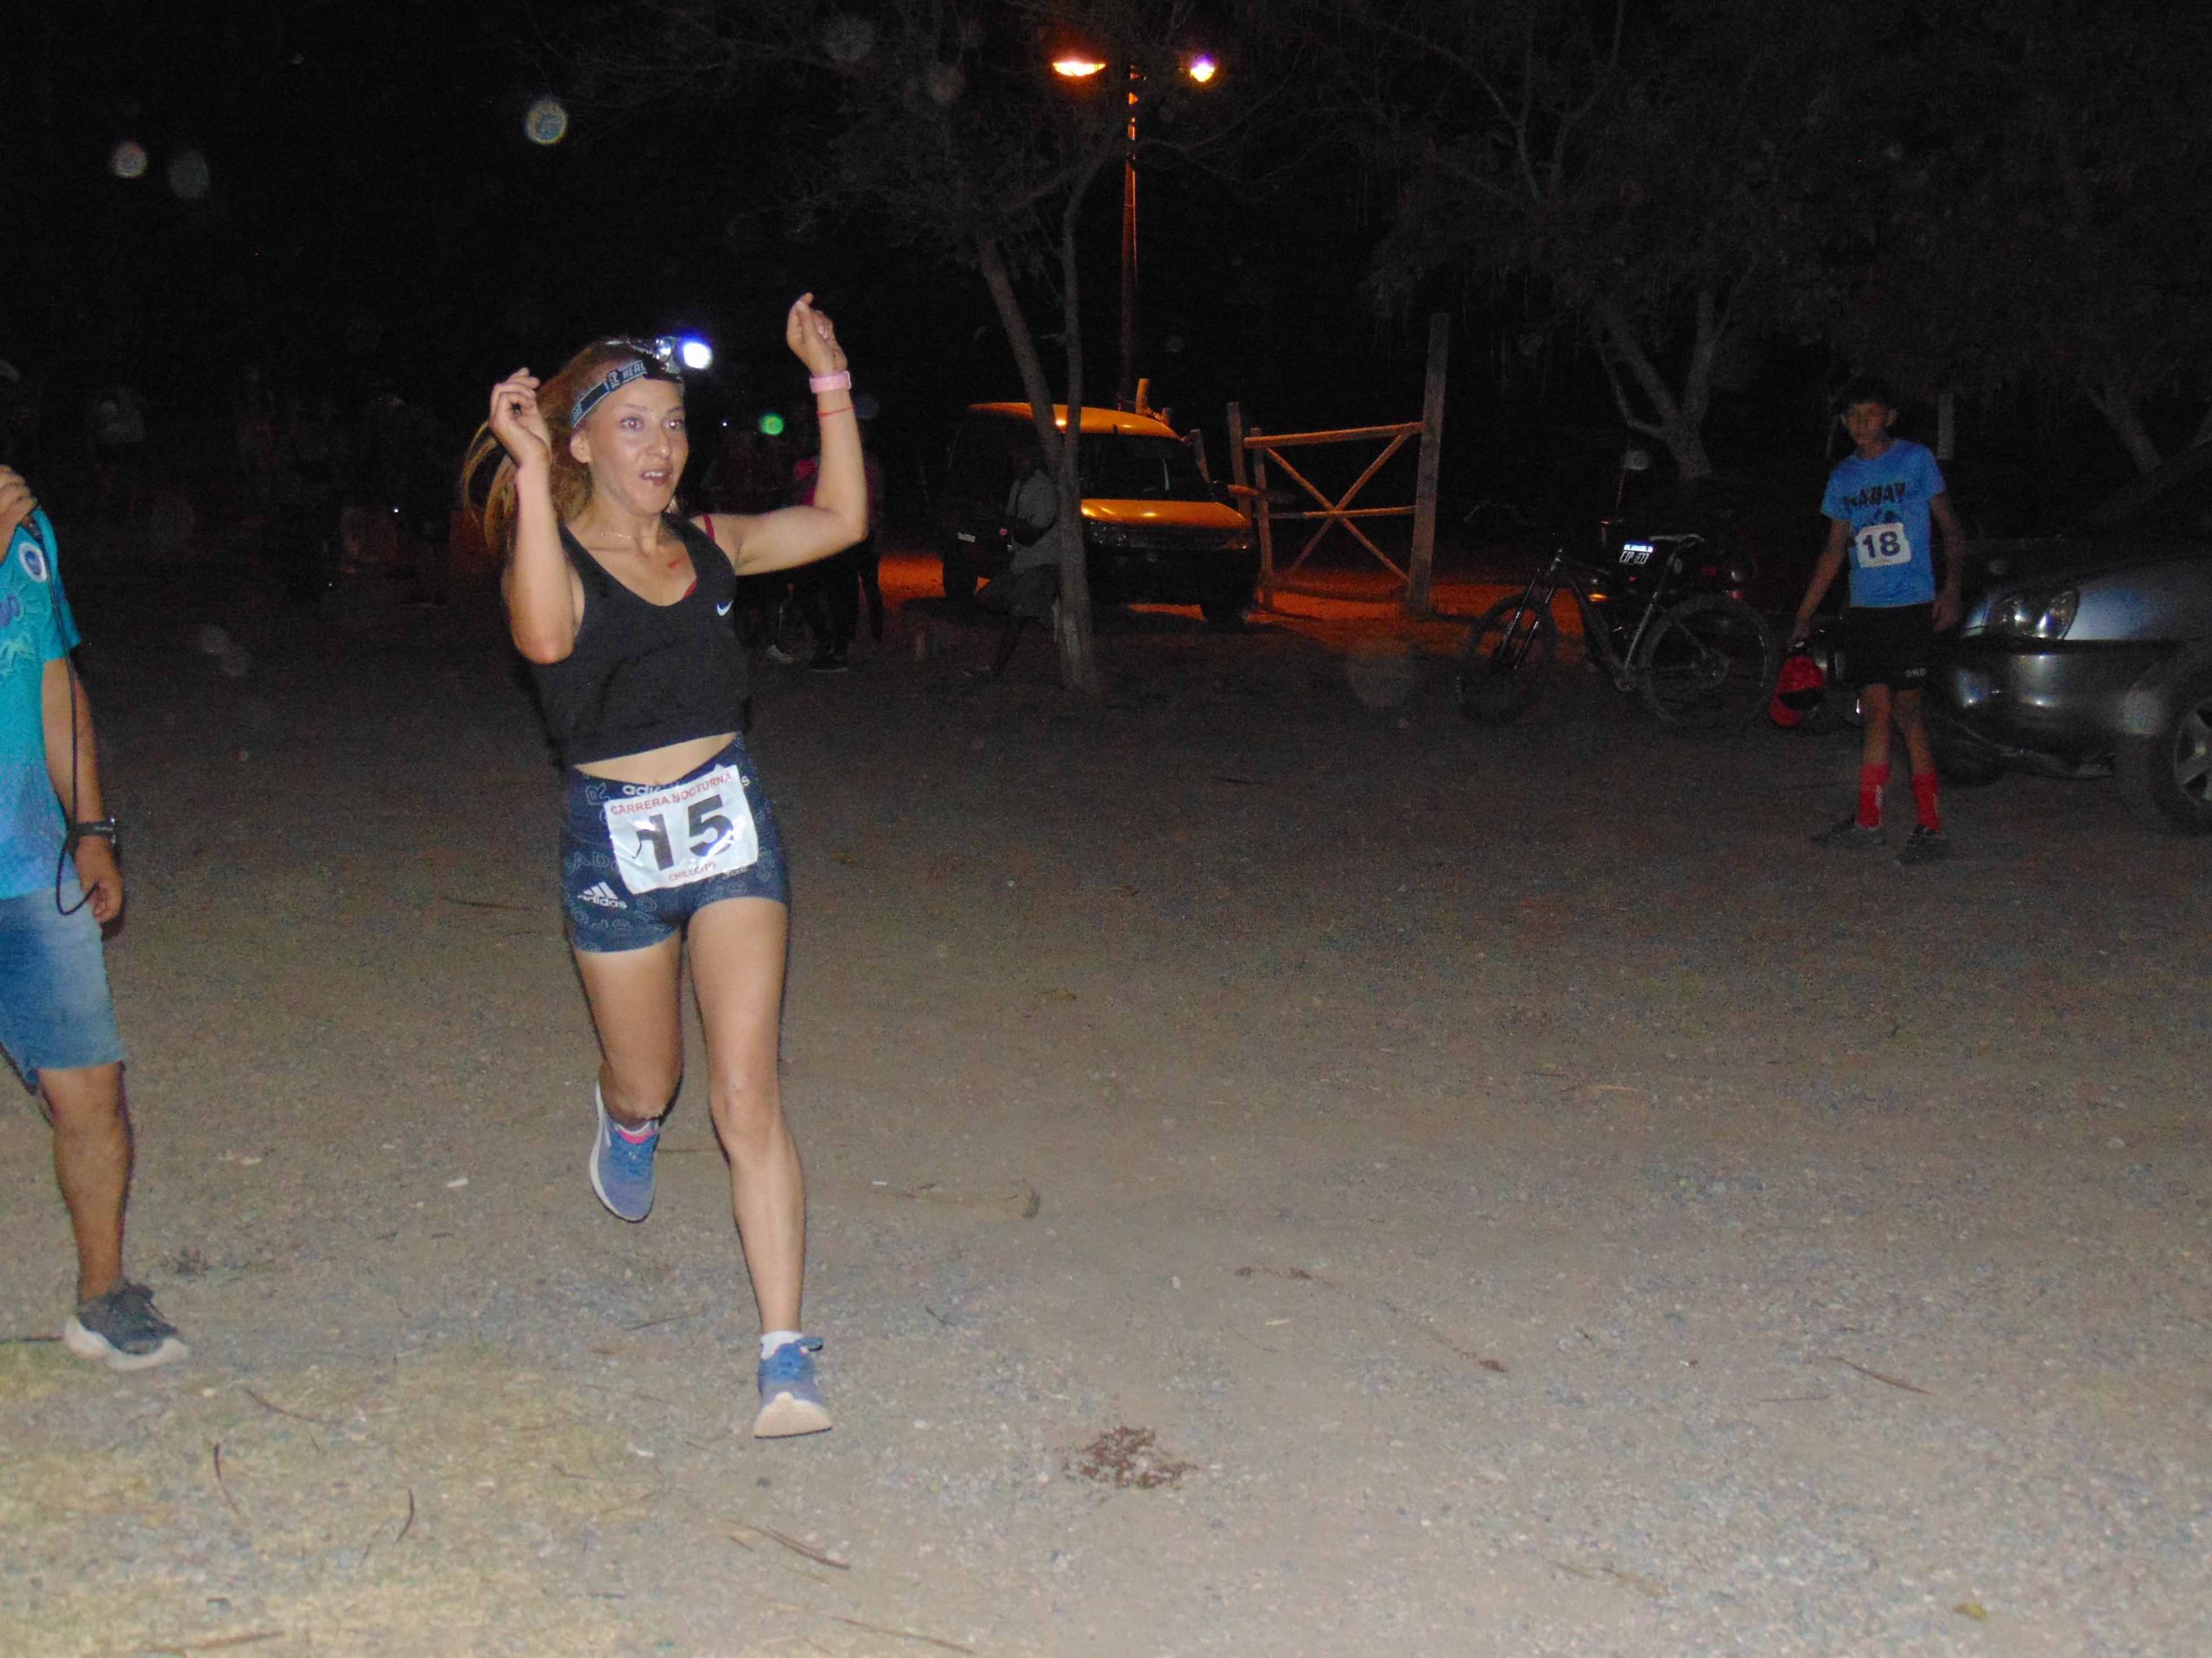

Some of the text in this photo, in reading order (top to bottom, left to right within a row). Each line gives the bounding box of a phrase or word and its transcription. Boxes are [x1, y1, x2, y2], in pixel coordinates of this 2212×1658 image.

[1862, 530, 1901, 559] 18
[611, 772, 733, 816] CARRERA NOCTURNA
[635, 793, 734, 872] 15
[577, 893, 627, 910] adidas
